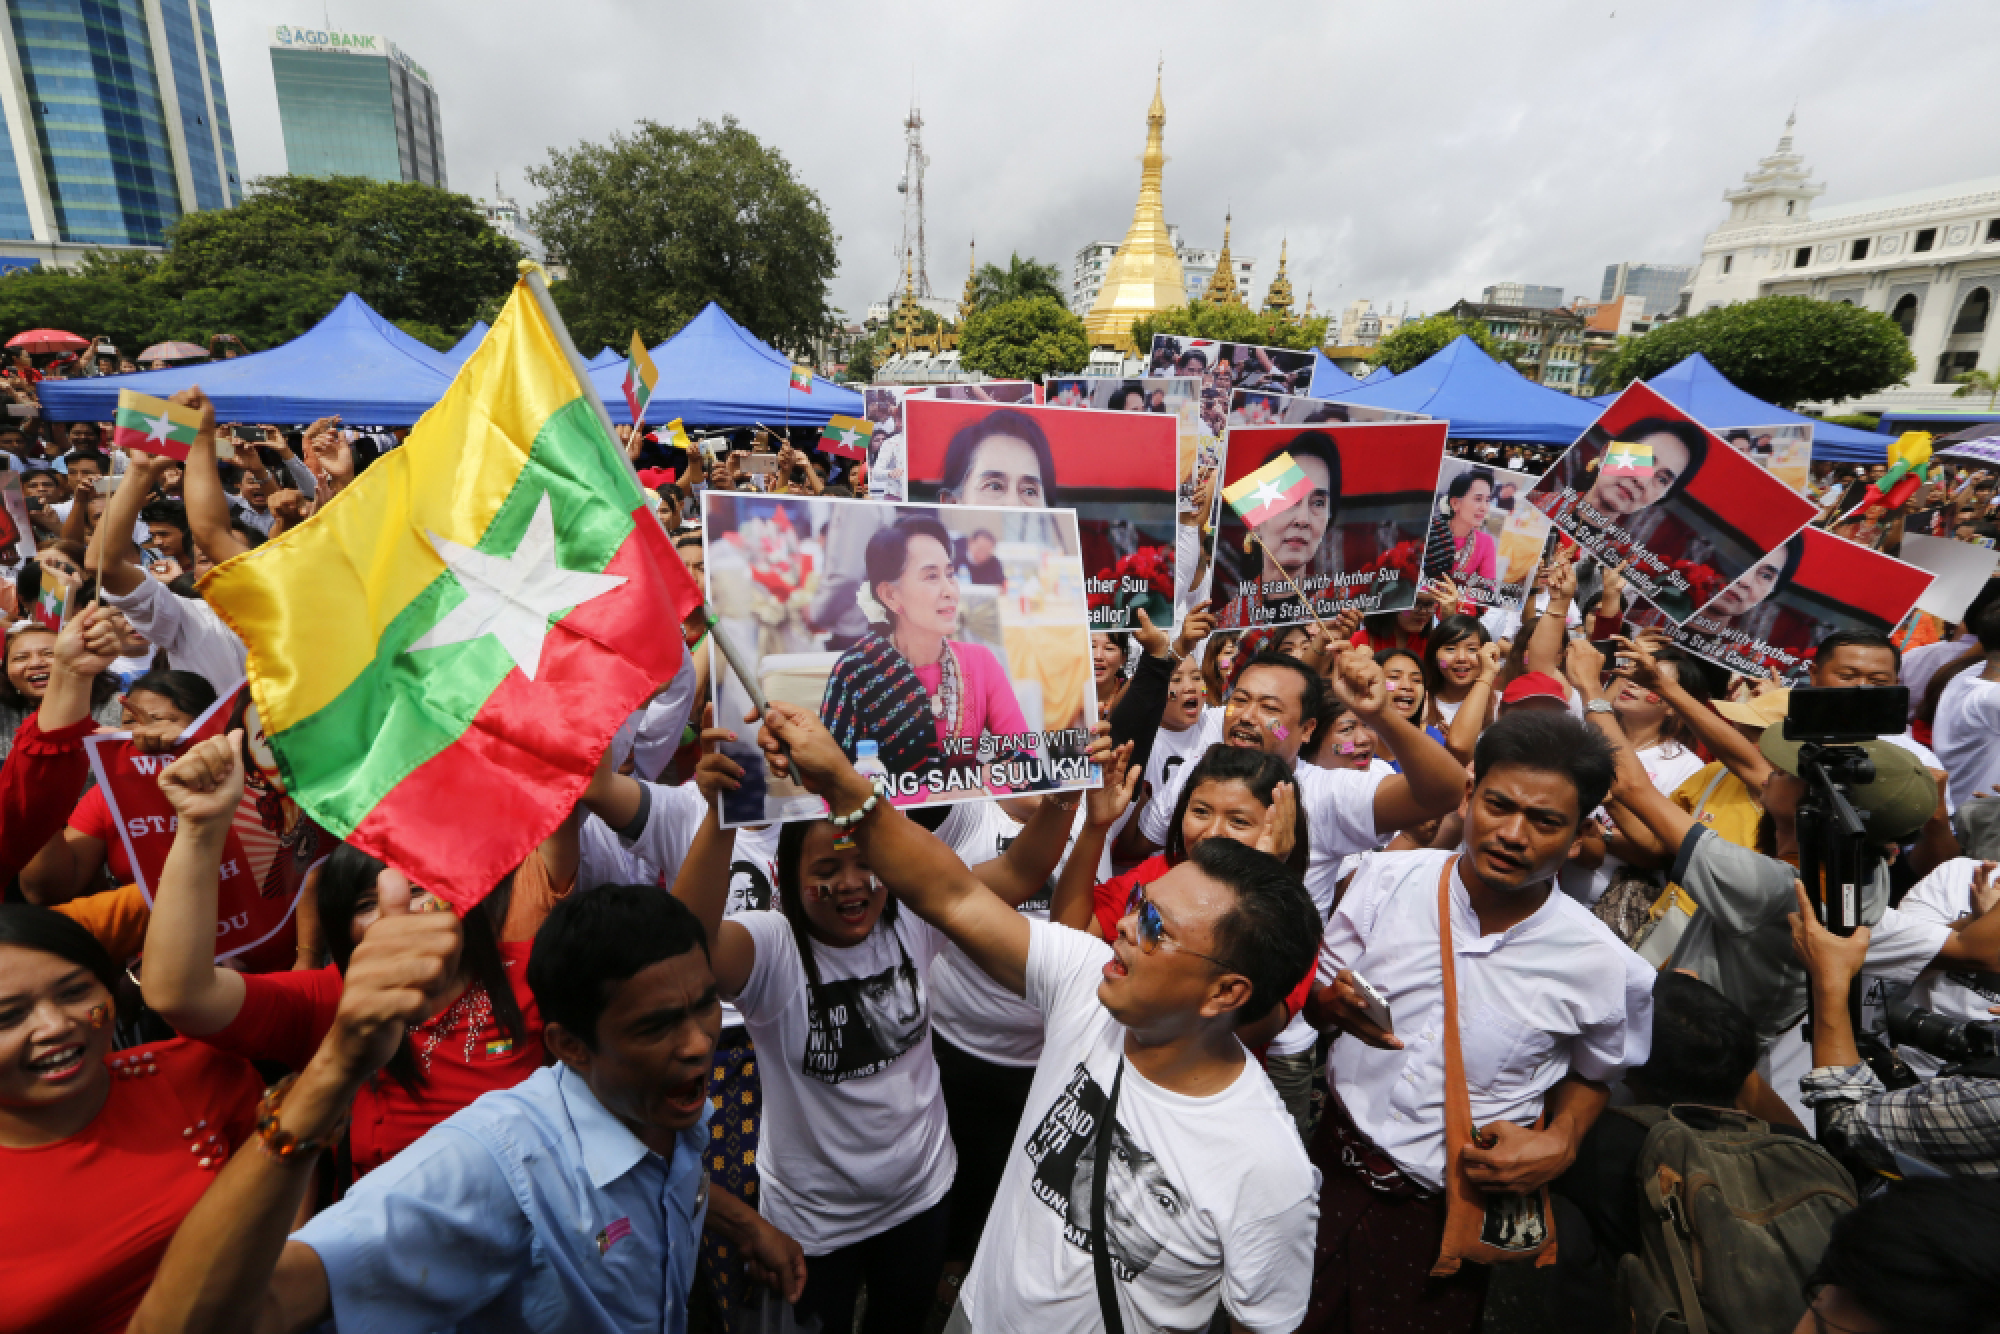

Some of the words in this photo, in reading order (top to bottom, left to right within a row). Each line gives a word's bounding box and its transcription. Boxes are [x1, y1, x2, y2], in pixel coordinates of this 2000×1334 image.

[1604, 547, 1663, 599] Cousellor)
[1630, 540, 1670, 573] Mother
[1667, 569, 1691, 591] Suu
[1084, 575, 1119, 593] ther
[1121, 575, 1149, 593] Suu
[1239, 580, 1257, 597] We
[1303, 573, 1331, 591] with
[1333, 569, 1377, 587] Mother
[1378, 567, 1400, 583] Suu
[1088, 604, 1131, 626] sellor)
[1693, 615, 1721, 632] and
[1751, 638, 1799, 667] Mother
[943, 737, 974, 756] WE
[979, 731, 1041, 754] STAND
[1043, 727, 1090, 748] WITH
[130, 754, 177, 776] WE
[871, 770, 919, 798] NG
[927, 766, 983, 794] SAN
[990, 758, 1043, 787] SUU
[1051, 755, 1090, 781] KYI
[128, 814, 179, 839] STA
[216, 911, 249, 937] OU
[807, 1051, 839, 1071] YOU
[1049, 1096, 1095, 1137] TAND
[1063, 1223, 1087, 1247] AN
